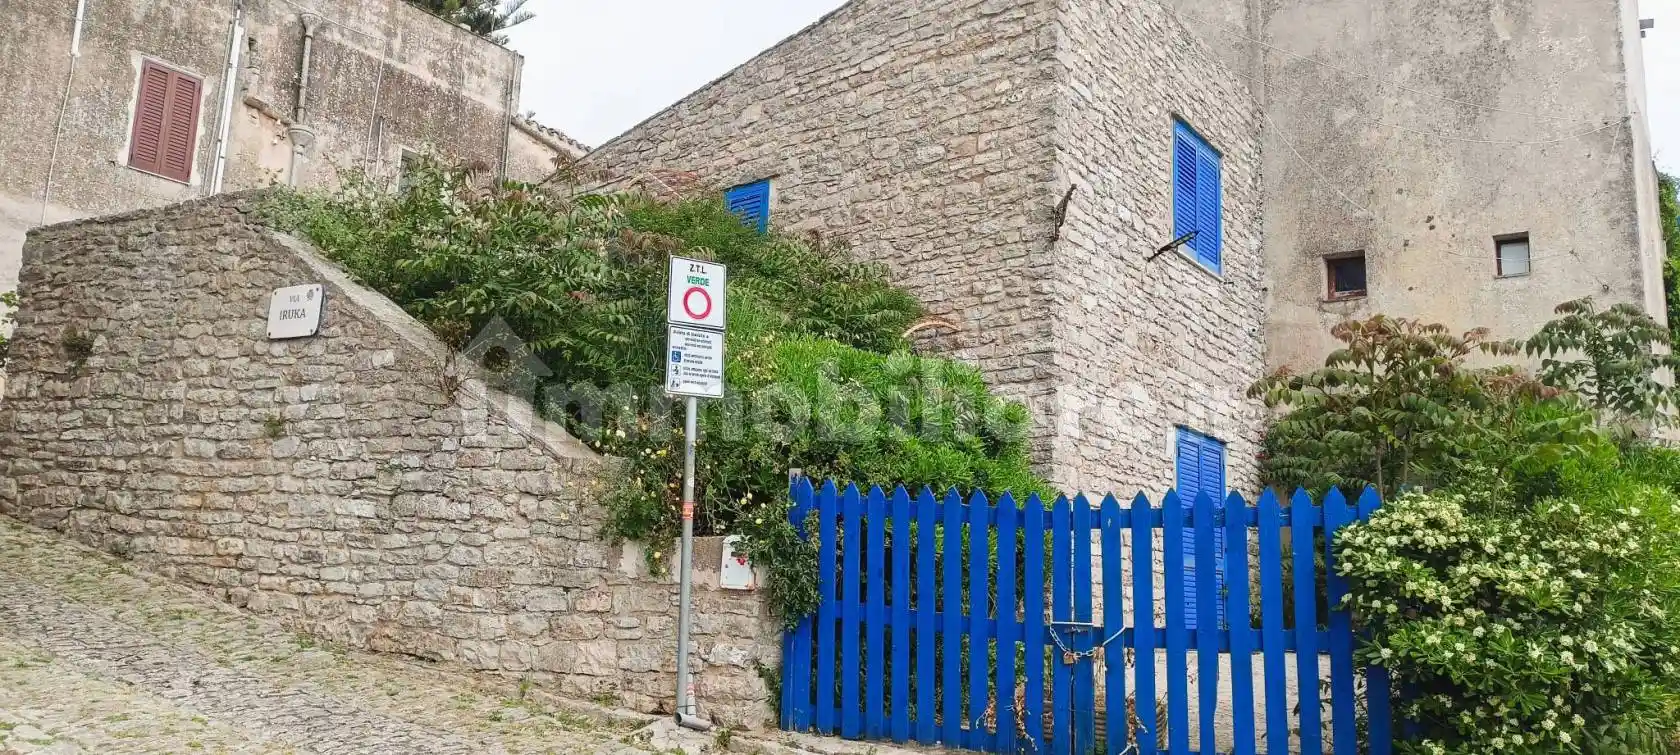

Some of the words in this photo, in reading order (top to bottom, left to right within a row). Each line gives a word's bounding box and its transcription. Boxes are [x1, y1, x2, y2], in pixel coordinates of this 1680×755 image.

[687, 275, 710, 287] VERDE
[289, 294, 300, 303] VIA
[279, 308, 306, 320] IRUKA
